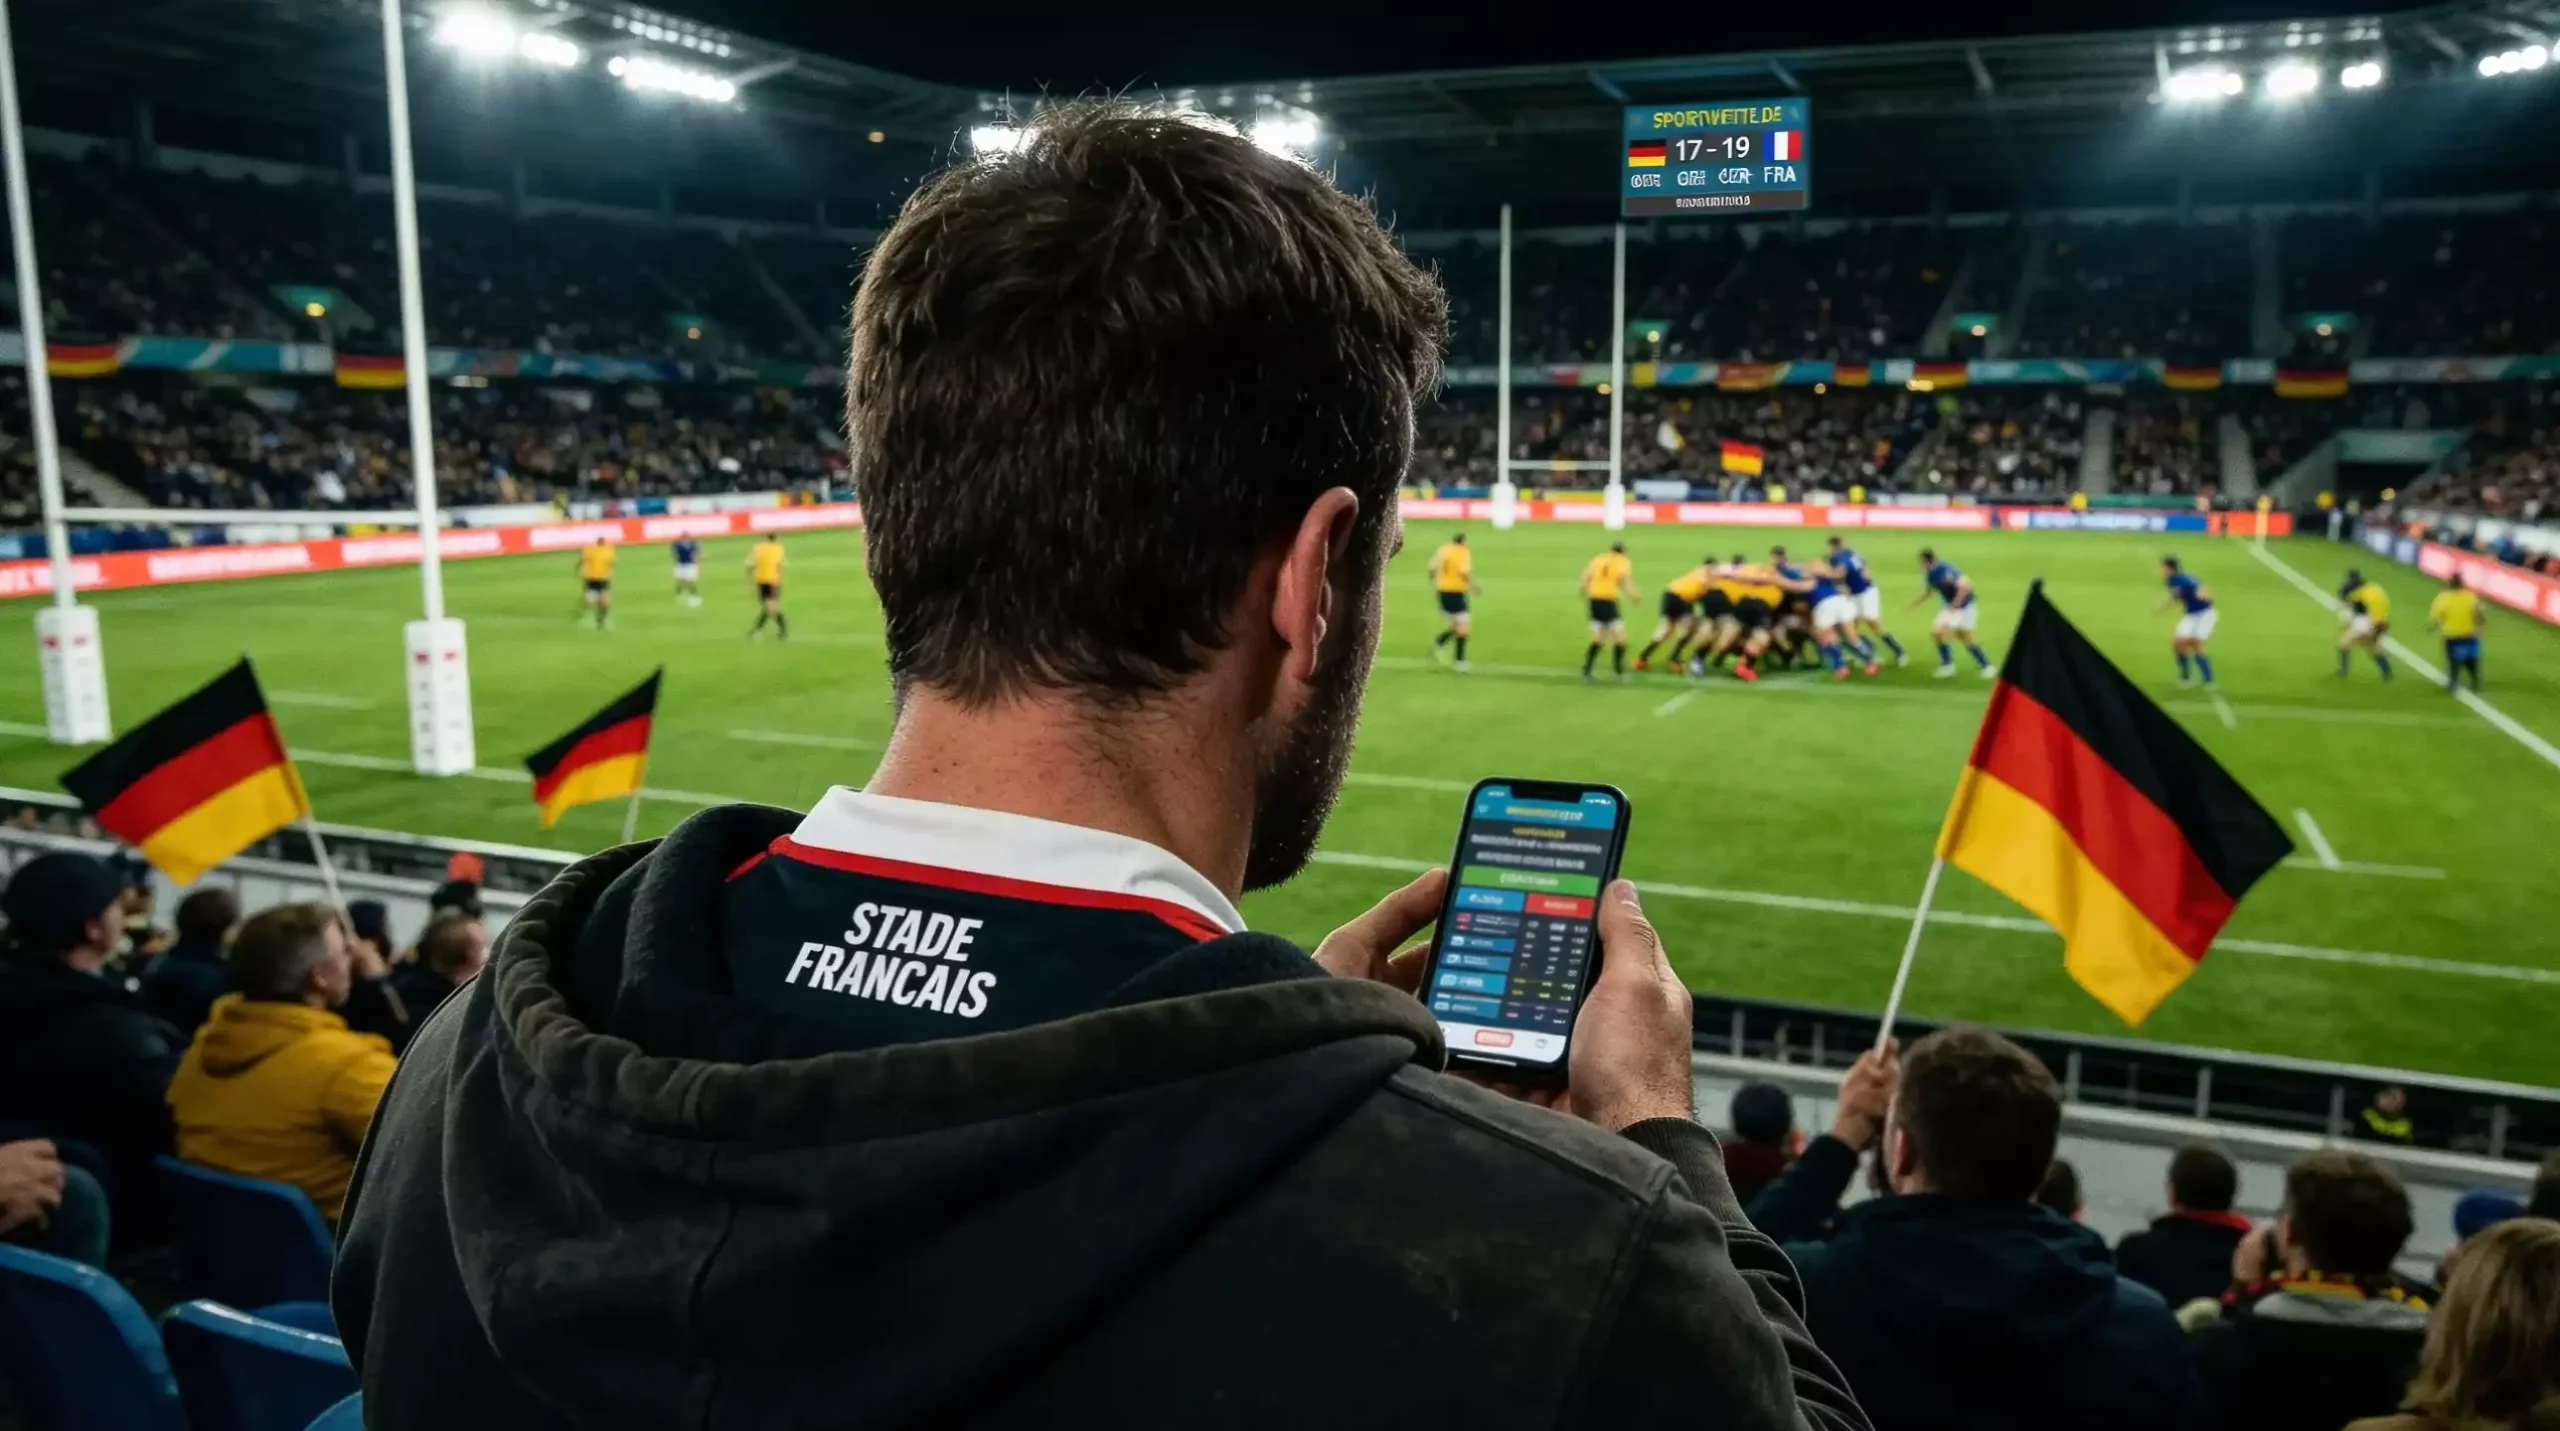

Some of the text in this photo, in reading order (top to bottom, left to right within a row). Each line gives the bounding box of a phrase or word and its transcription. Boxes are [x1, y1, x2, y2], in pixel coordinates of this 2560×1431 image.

[1763, 166, 1797, 183] FRA
[843, 901, 984, 962] STADE
[784, 941, 997, 1018] FRANCAIS
